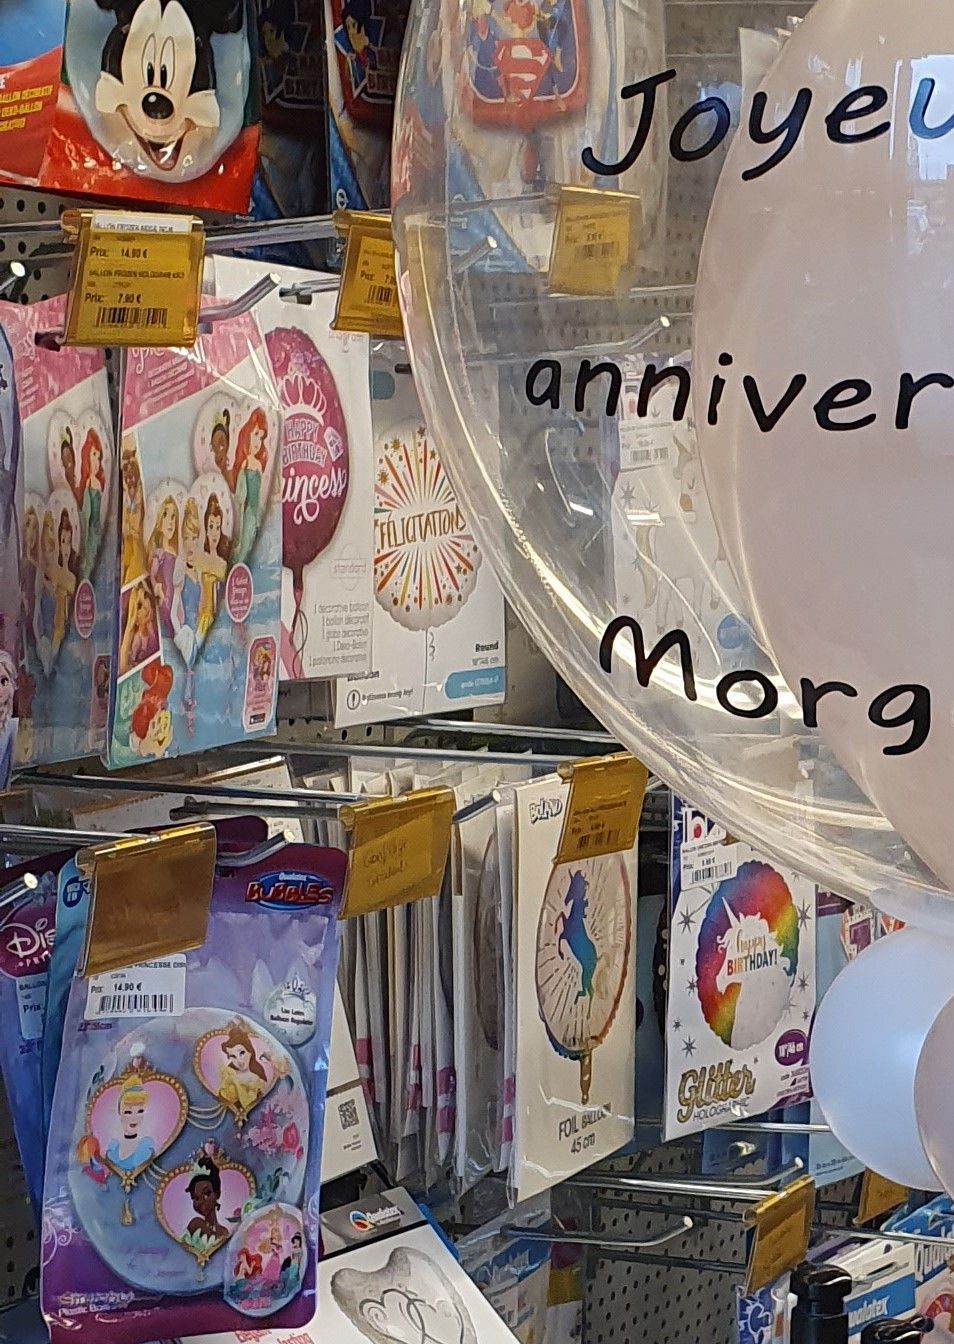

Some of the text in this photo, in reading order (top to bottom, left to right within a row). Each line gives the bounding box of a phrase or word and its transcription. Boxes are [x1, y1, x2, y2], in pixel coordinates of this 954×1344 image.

[285, 418, 319, 443] HAPPY
[726, 947, 779, 977] BIRTHDAY!
[114, 983, 135, 992] 14.90
[136, 982, 142, 992] €
[676, 1058, 757, 1124] Glitter
[558, 1117, 580, 1142] FOIL
[570, 1137, 582, 1155] 45
